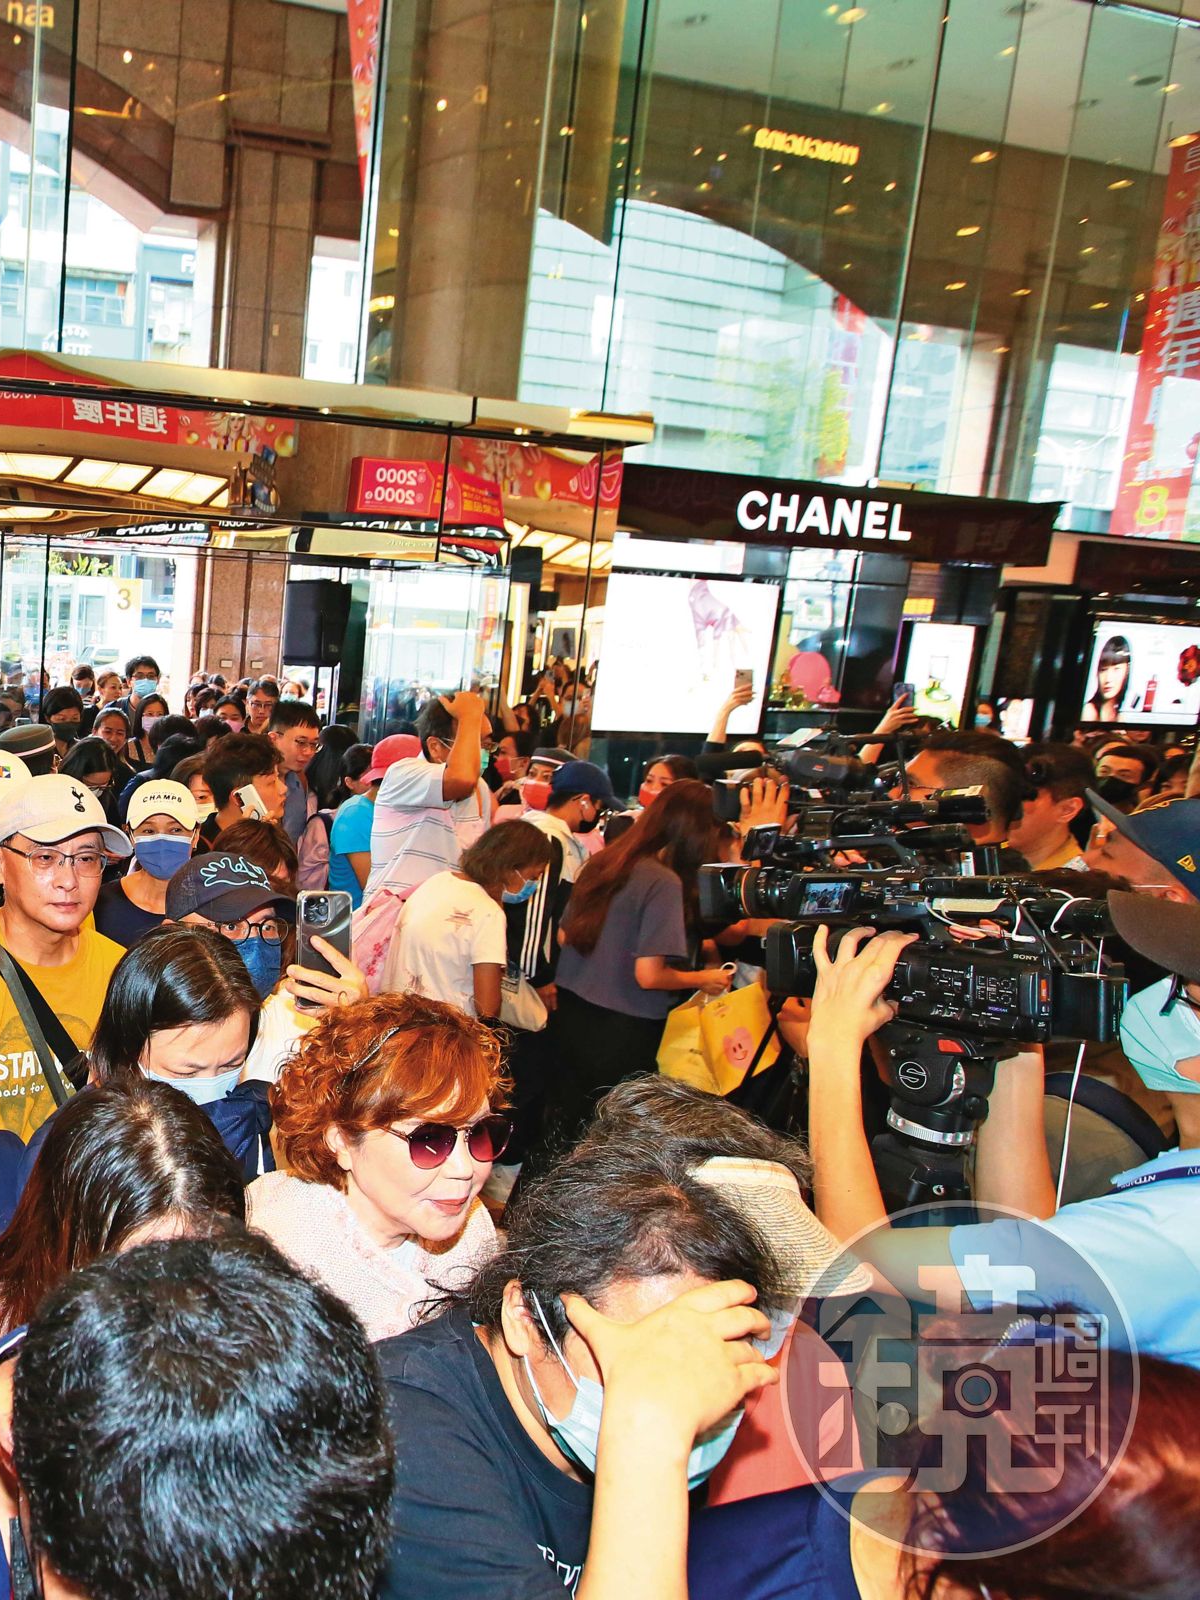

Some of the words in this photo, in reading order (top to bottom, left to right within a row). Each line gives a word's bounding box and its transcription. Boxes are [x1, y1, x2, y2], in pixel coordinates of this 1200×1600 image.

[41, 341, 93, 357] PAETTE
[736, 489, 912, 542] CHANEL
[117, 588, 132, 610] 3
[1012, 953, 1039, 961] SONY
[30, 1081, 45, 1094] for
